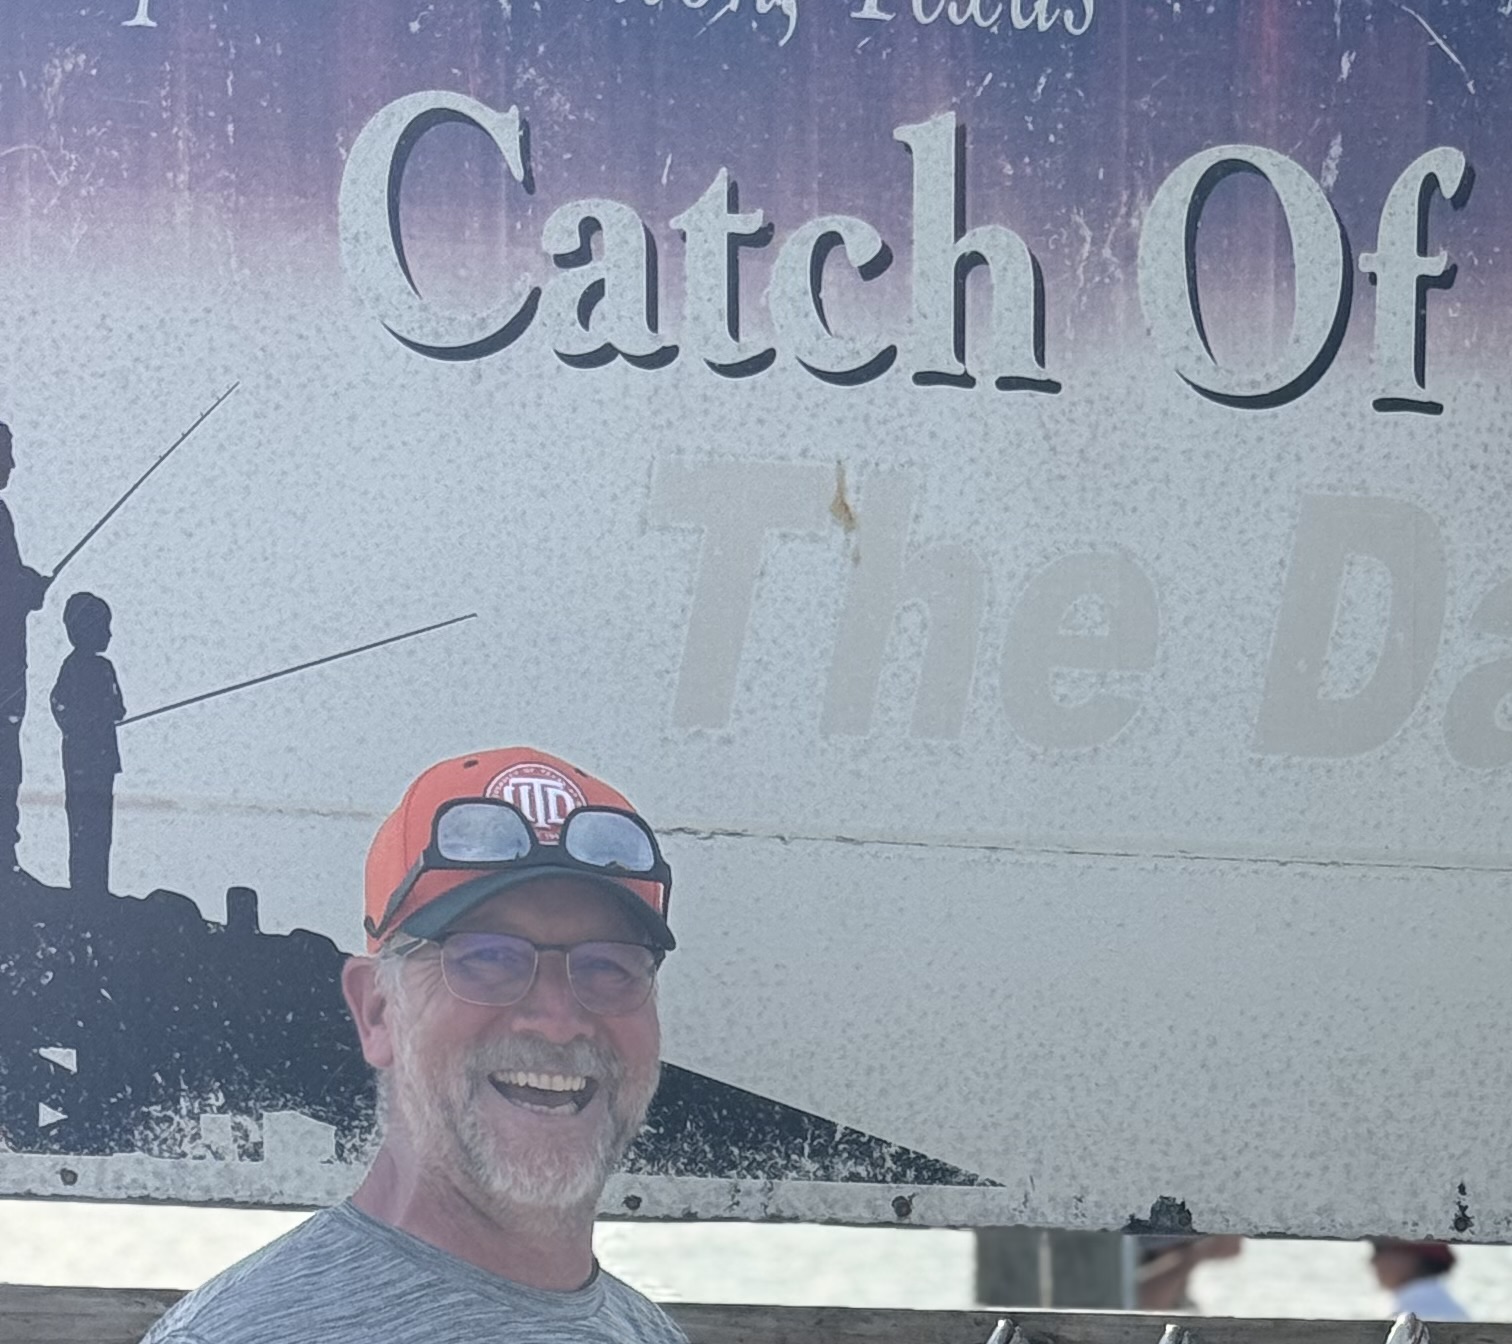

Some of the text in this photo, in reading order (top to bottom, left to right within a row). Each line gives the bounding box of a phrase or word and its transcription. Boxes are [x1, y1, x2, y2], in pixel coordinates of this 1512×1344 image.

[338, 90, 1476, 416] Catch Of
[641, 455, 1162, 752] The
